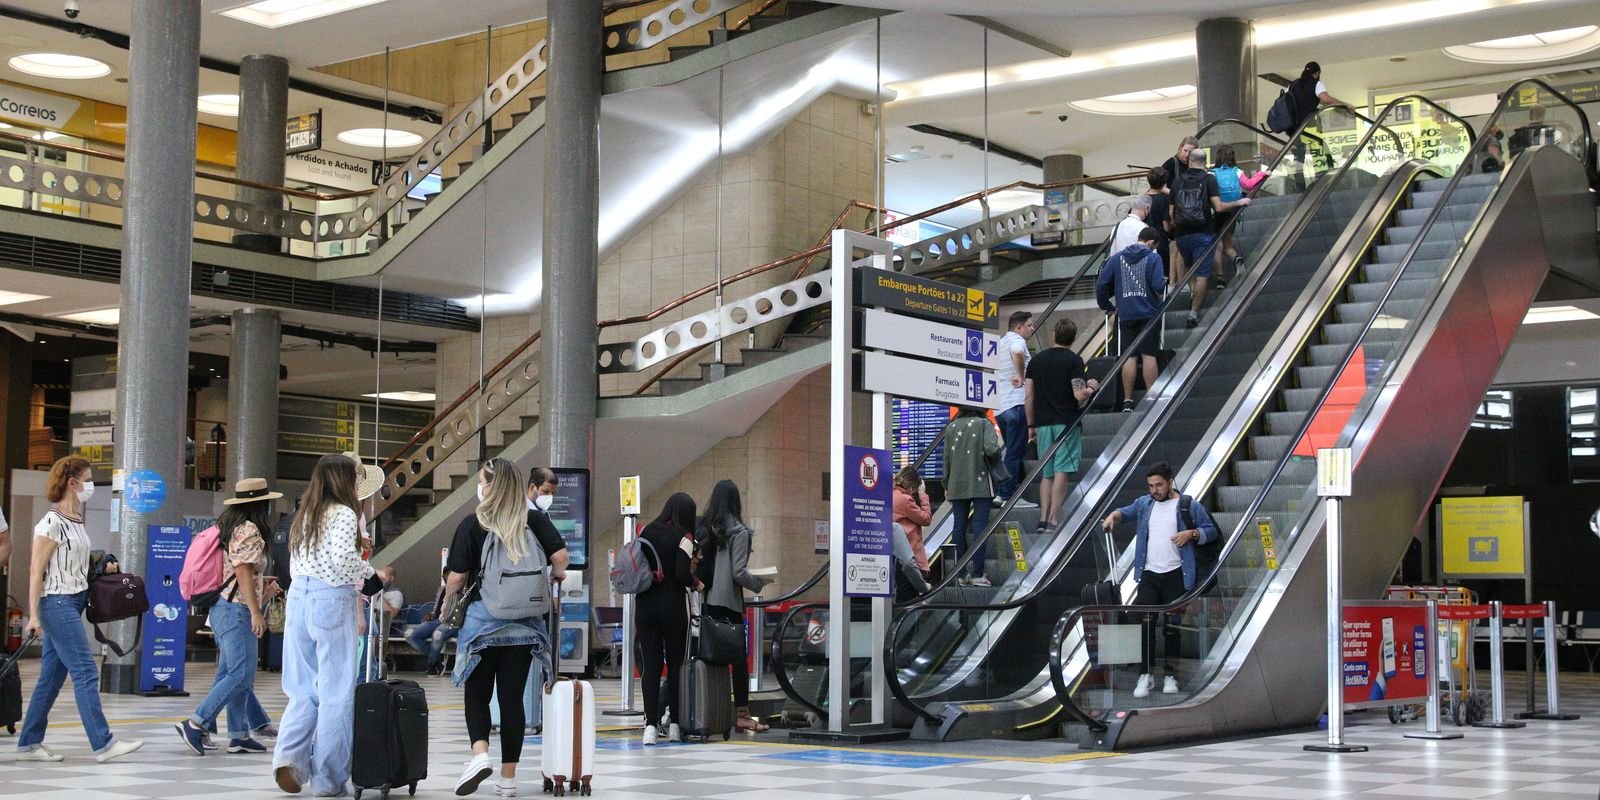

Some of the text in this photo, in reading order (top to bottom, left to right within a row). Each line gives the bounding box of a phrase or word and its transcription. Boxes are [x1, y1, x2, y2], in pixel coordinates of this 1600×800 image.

[0, 98, 57, 121] Correios
[334, 161, 368, 174] Achados
[321, 168, 333, 177] and
[334, 170, 352, 181] found
[878, 276, 965, 303] Embarque Portões 1 a 22
[905, 298, 932, 311] Departure
[933, 303, 948, 314] Gates
[951, 307, 957, 316] to
[958, 308, 965, 317] 22
[930, 333, 963, 346] Restaurante
[937, 348, 963, 360] Restaurant
[935, 389, 959, 400] Drugstore
[1343, 620, 1371, 630] Quer aprender
[1346, 630, 1360, 638] melhor
[1360, 630, 1372, 638] forma
